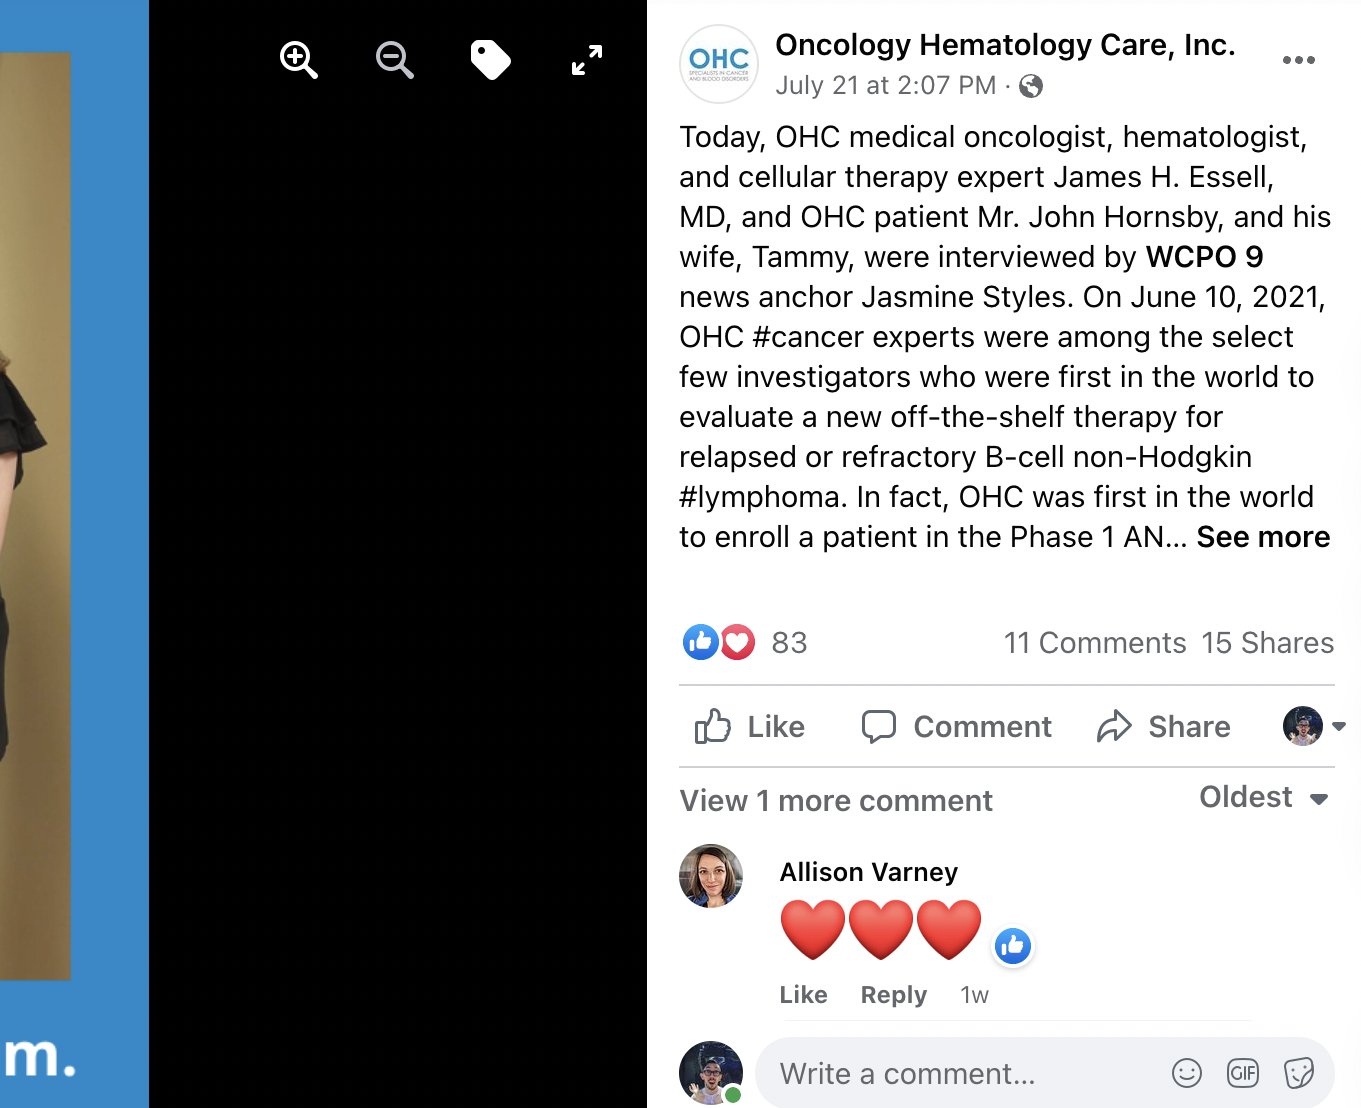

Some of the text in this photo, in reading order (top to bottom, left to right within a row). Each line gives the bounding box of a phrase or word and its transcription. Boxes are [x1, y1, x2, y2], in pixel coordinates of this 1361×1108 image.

[689, 48, 749, 69] OHC
[775, 32, 1235, 62] Oncology Hematology Care, Inc.
[775, 74, 996, 100] July 21 at 2:07 PM
[679, 124, 1307, 154] Today, OHC medical oncologist, hematologist,
[679, 164, 1273, 194] and cellular therapy expert James H. Essell,
[680, 204, 1331, 234] MD, and OHC patient Mr. John Hornsby, and his
[679, 244, 1264, 274] wife, Tammy, were interviewed by WCPO 9
[680, 284, 1325, 314] news anchor Jasmine Styles. On June 10, 2021,
[679, 324, 1294, 354] OHC #cancer experts were among the select
[678, 364, 1315, 394] few investigators who were first in the world to
[679, 404, 1224, 434] evaluate a new off-the-shelf therapy for
[680, 444, 1252, 474] relapsed or refractory B-cell non-Hodgkin
[678, 484, 1314, 514] #lymphoma. In fact, OHC was first in the world
[678, 524, 1187, 553] to enroll a patient in the Phase 1 AN...
[1197, 524, 1331, 549] See more
[772, 630, 807, 654] 83
[1004, 630, 1187, 655] 11 Comments
[1202, 630, 1335, 654] 15 Shares
[749, 713, 805, 738] Like
[914, 714, 1052, 739] Comment
[1149, 714, 1231, 738] Share
[679, 787, 993, 812] View 1 more comment
[1199, 784, 1293, 808] Oldest
[779, 860, 959, 887] Allison Varney
[780, 983, 828, 1004] Like
[861, 984, 928, 1009] Reply
[960, 985, 990, 1004] 1w
[779, 1061, 1035, 1085] Write a comment...
[1230, 1065, 1256, 1081] GIF
